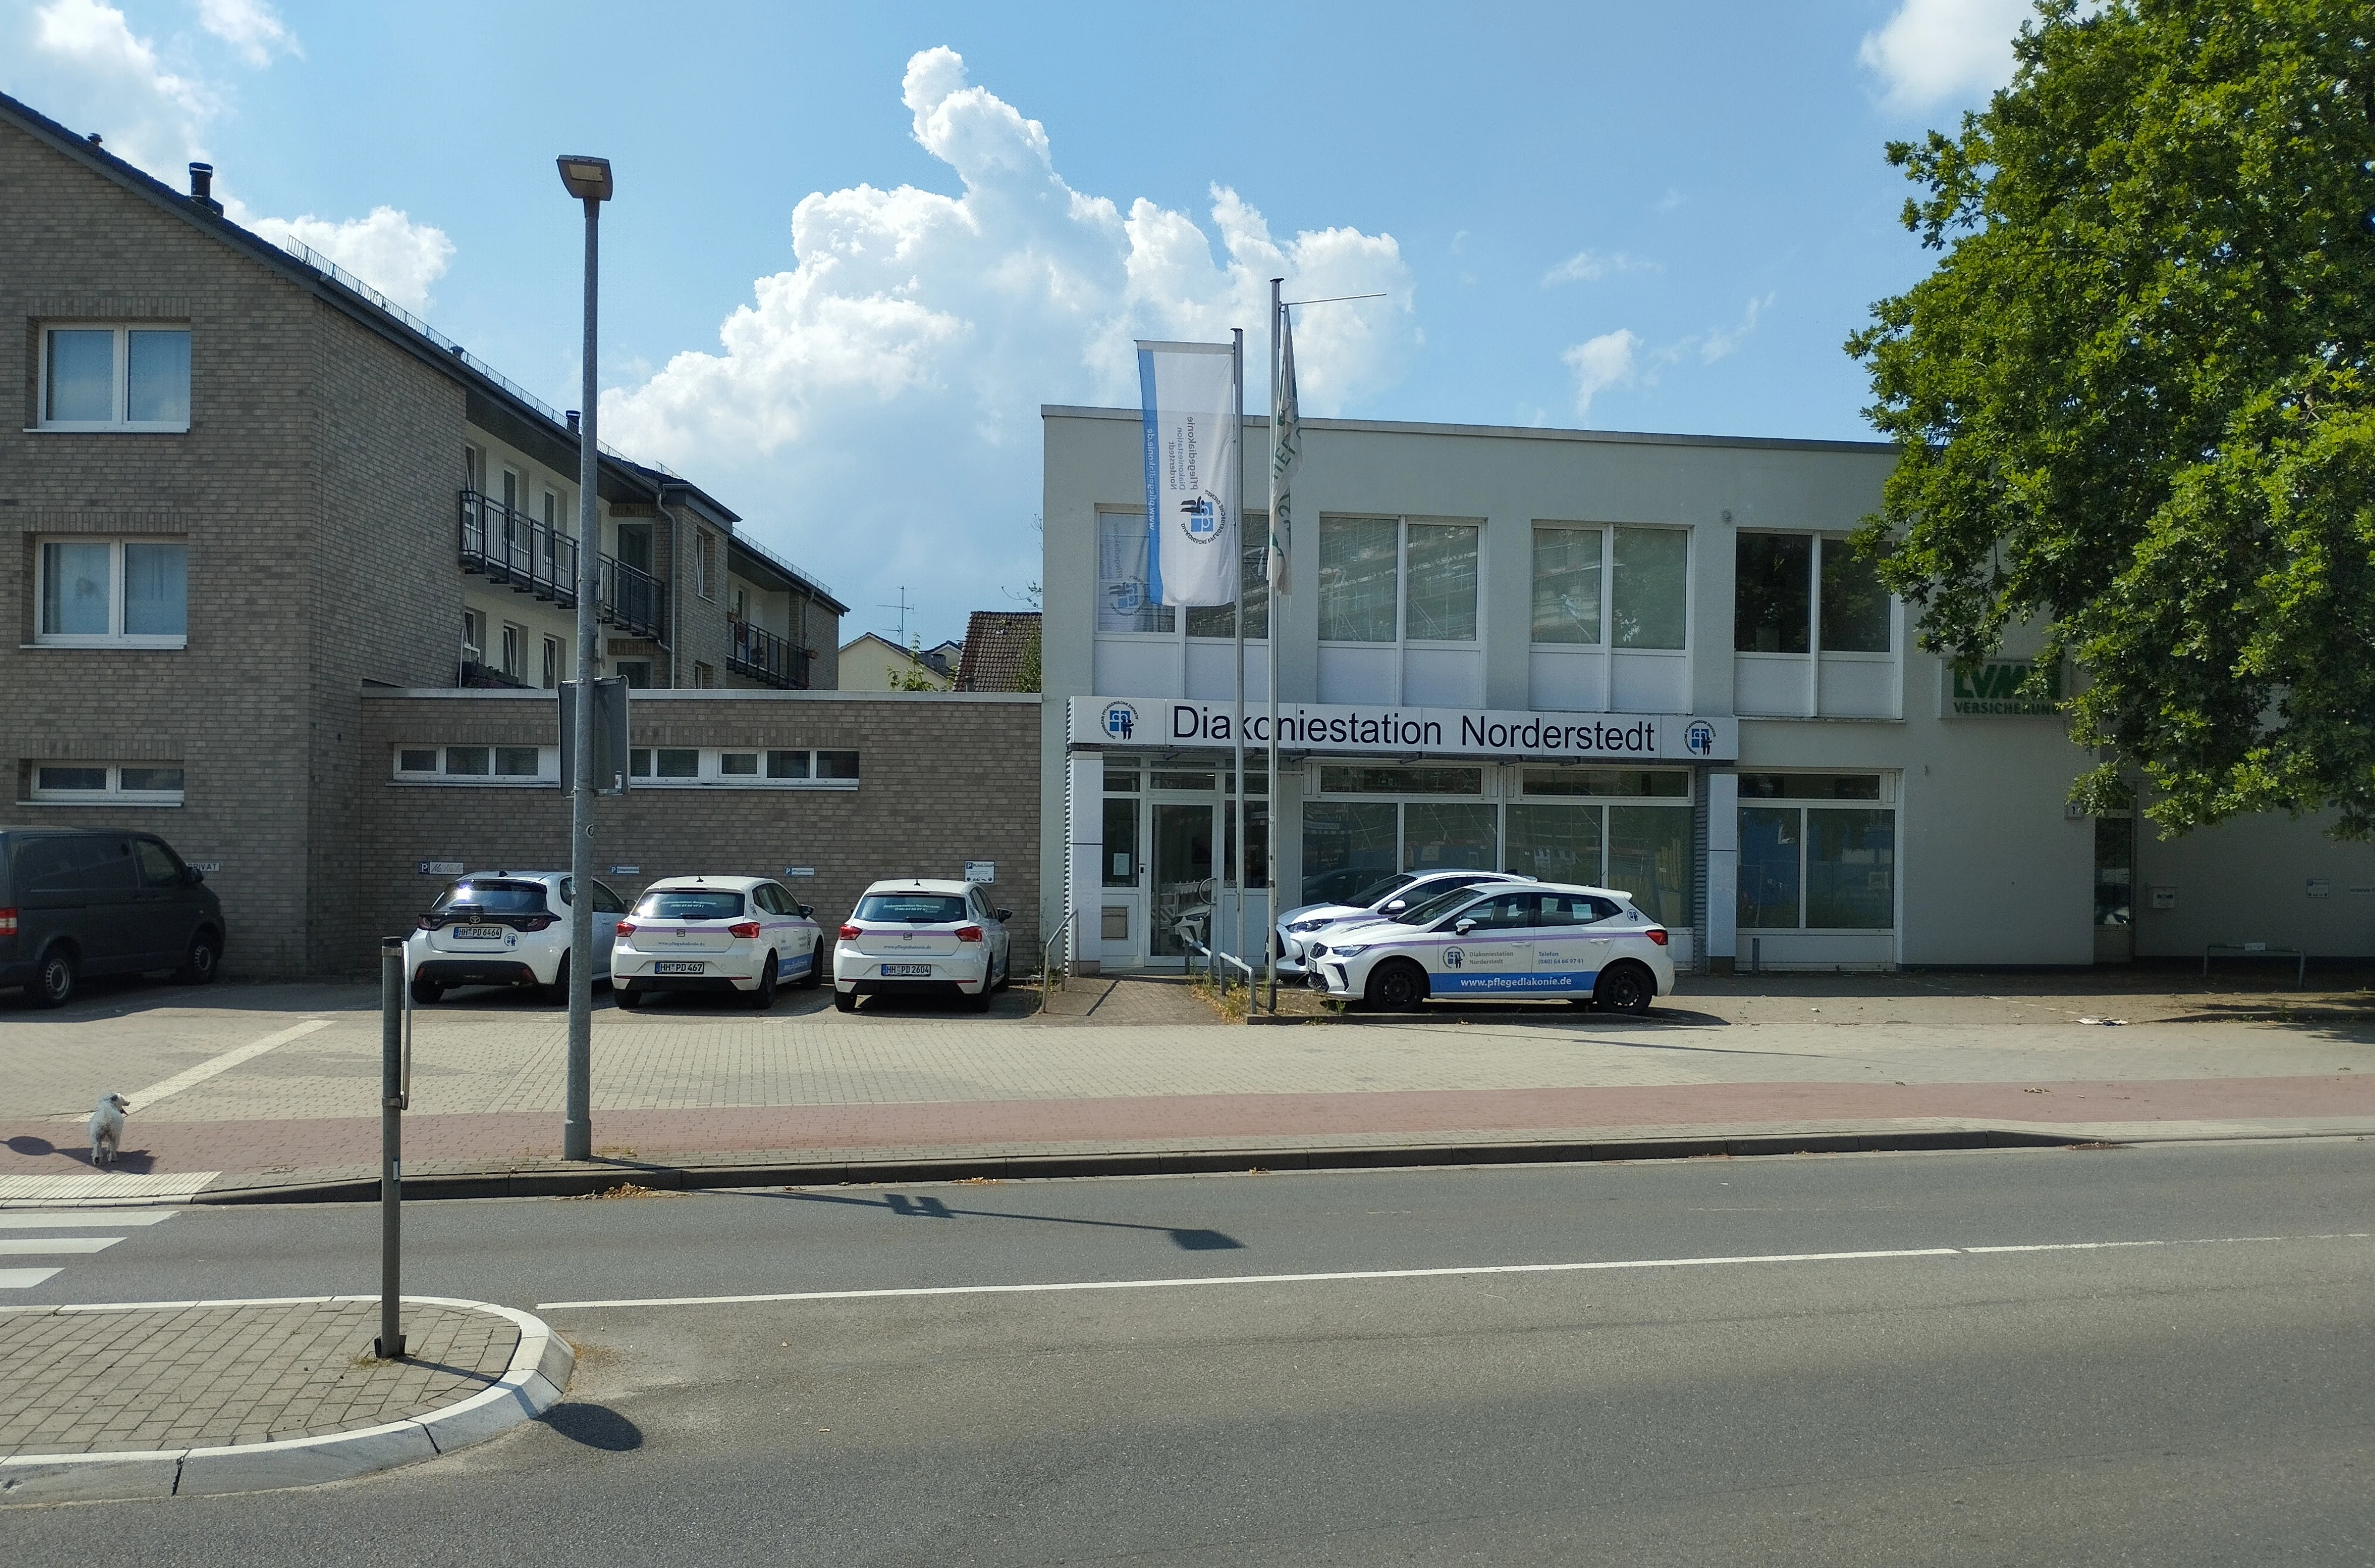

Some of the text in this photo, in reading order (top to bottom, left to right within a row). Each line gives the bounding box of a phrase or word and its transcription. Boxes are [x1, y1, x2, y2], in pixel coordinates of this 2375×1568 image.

[1173, 706, 1441, 745] Diakoniestation
[1462, 715, 1655, 751] Norderstedt
[1461, 976, 1572, 988] www.pflegediakonie.de
